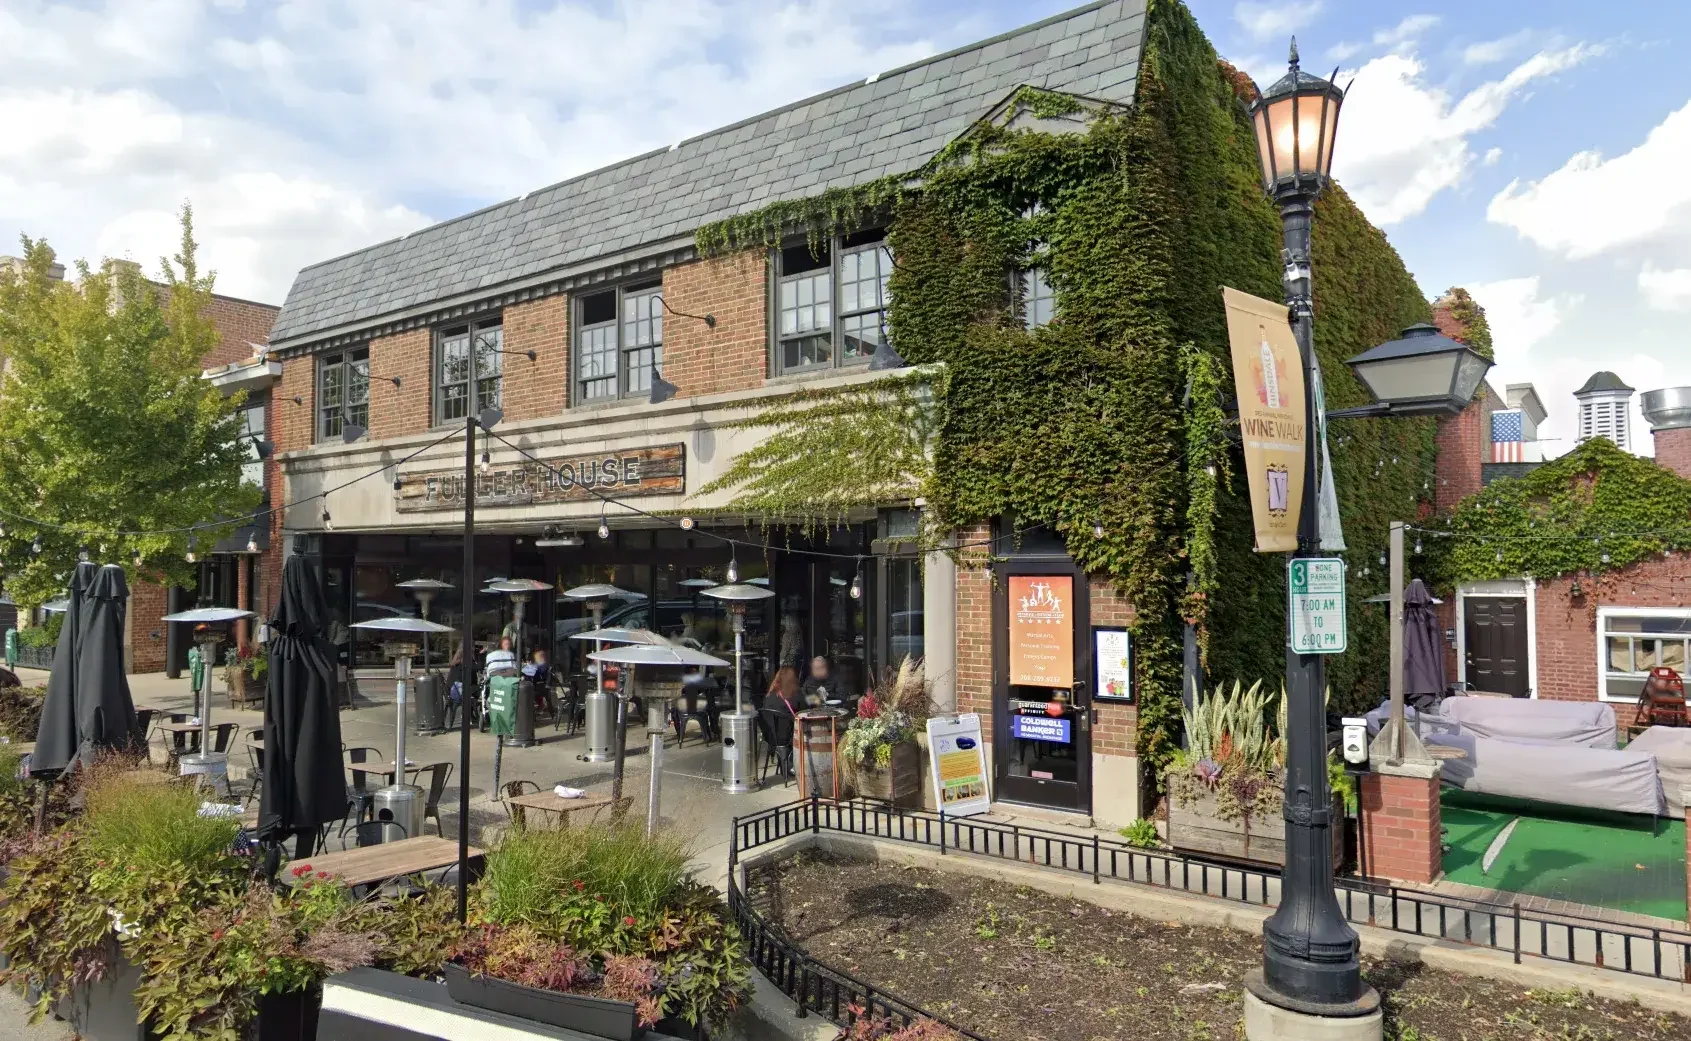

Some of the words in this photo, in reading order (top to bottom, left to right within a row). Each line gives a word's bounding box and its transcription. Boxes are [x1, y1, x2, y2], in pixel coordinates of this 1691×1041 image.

[1263, 349, 1277, 407] HINSDALE
[1243, 417, 1274, 438] WINE
[1275, 421, 1304, 441] WALK
[537, 455, 641, 493] HOUSE
[1294, 563, 1306, 587] 3
[1310, 573, 1338, 581] PARKING
[1301, 599, 1320, 611] 7:00
[1323, 599, 1335, 611] AM
[1313, 616, 1324, 628] TO
[1302, 633, 1321, 646] 6:00
[1324, 633, 1336, 645] PM
